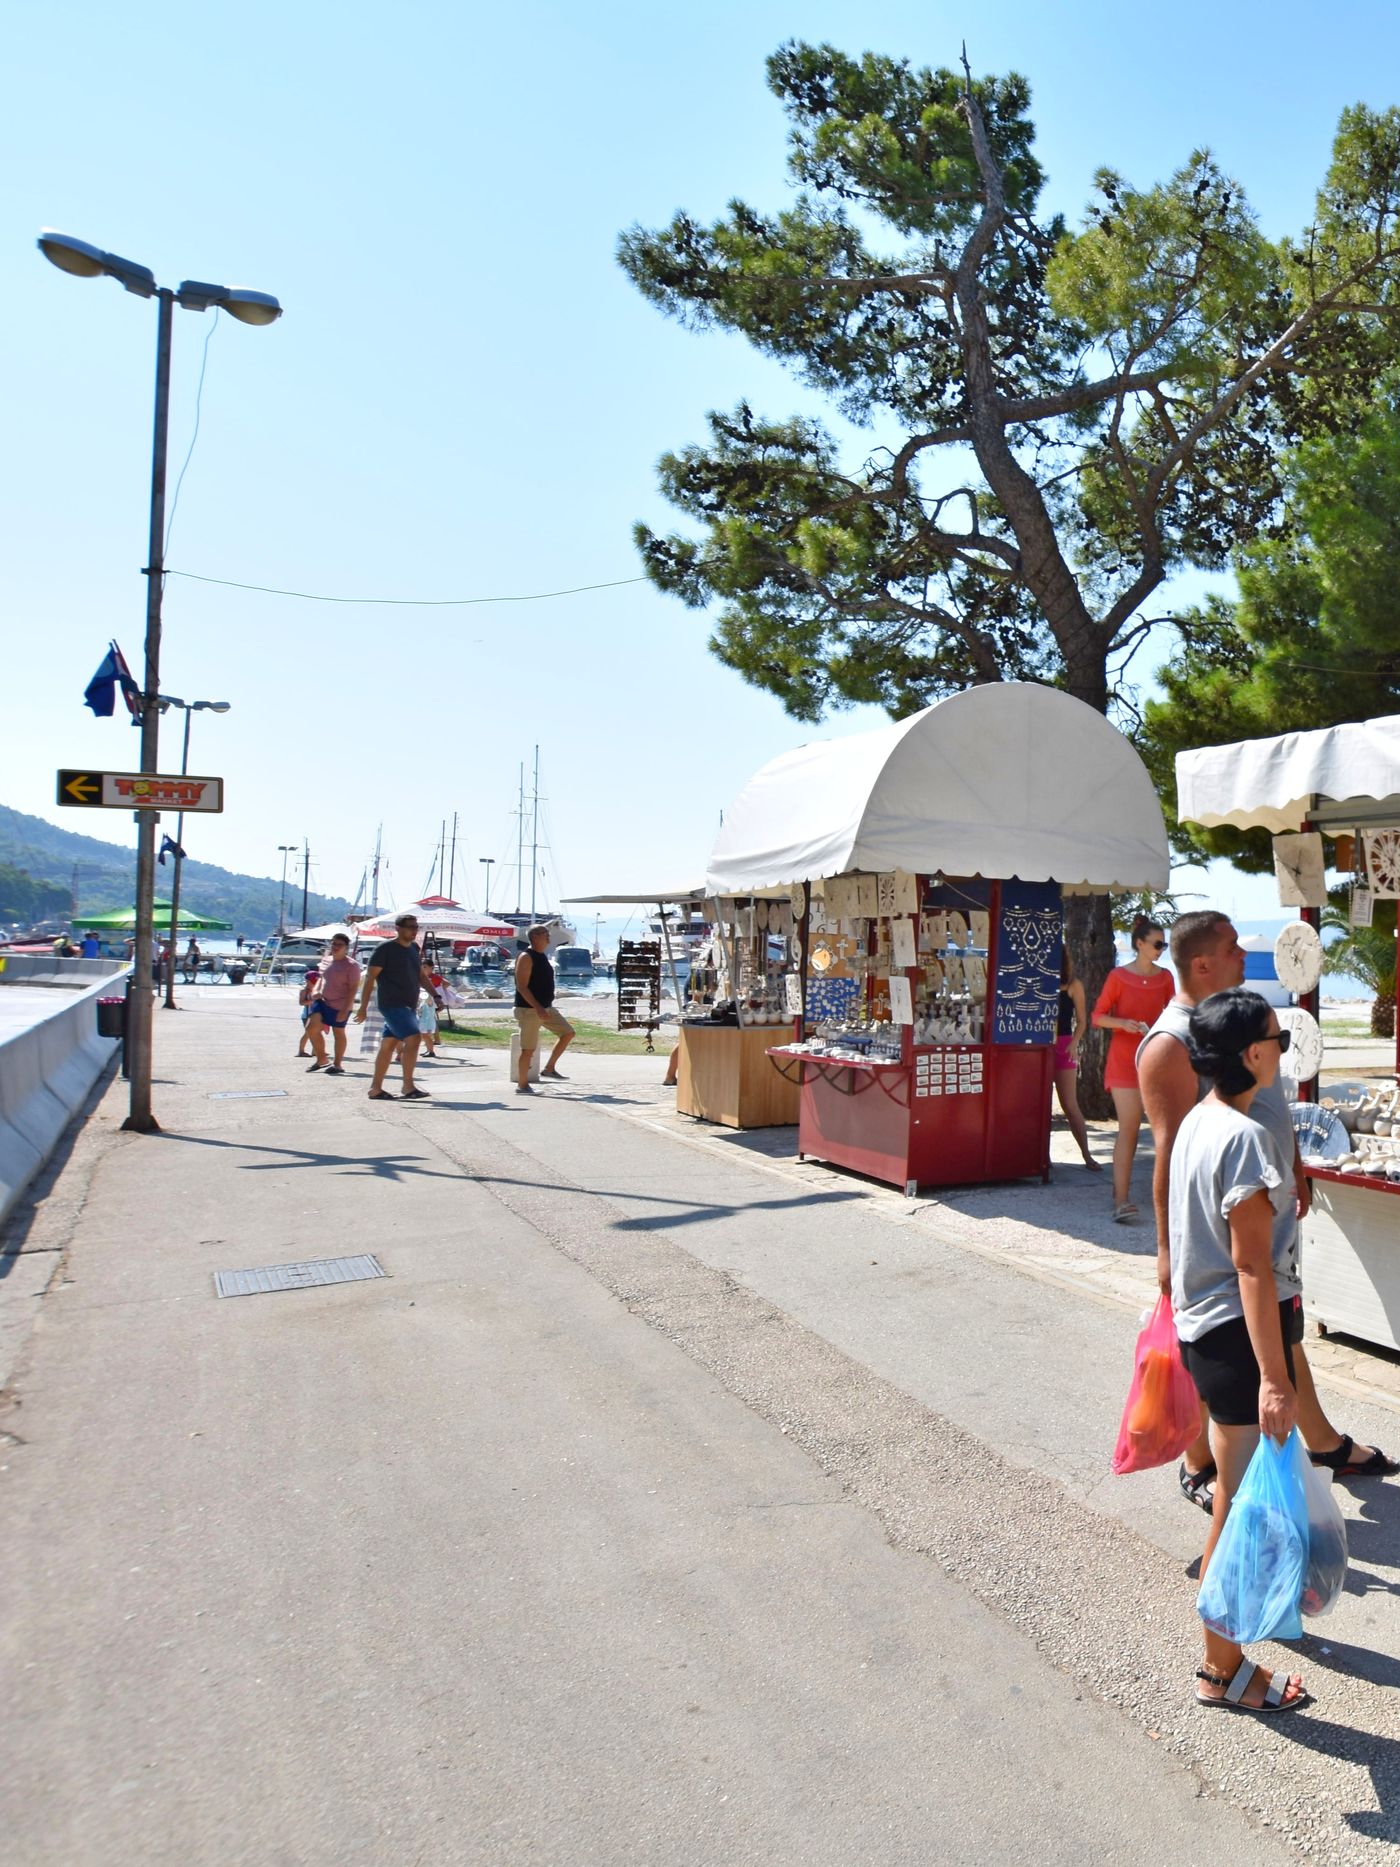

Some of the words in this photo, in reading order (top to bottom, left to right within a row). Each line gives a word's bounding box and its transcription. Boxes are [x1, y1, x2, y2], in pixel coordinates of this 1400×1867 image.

[115, 779, 207, 798] TOMMY
[1290, 1014, 1303, 1031] 12
[1310, 1039, 1318, 1056] 3
